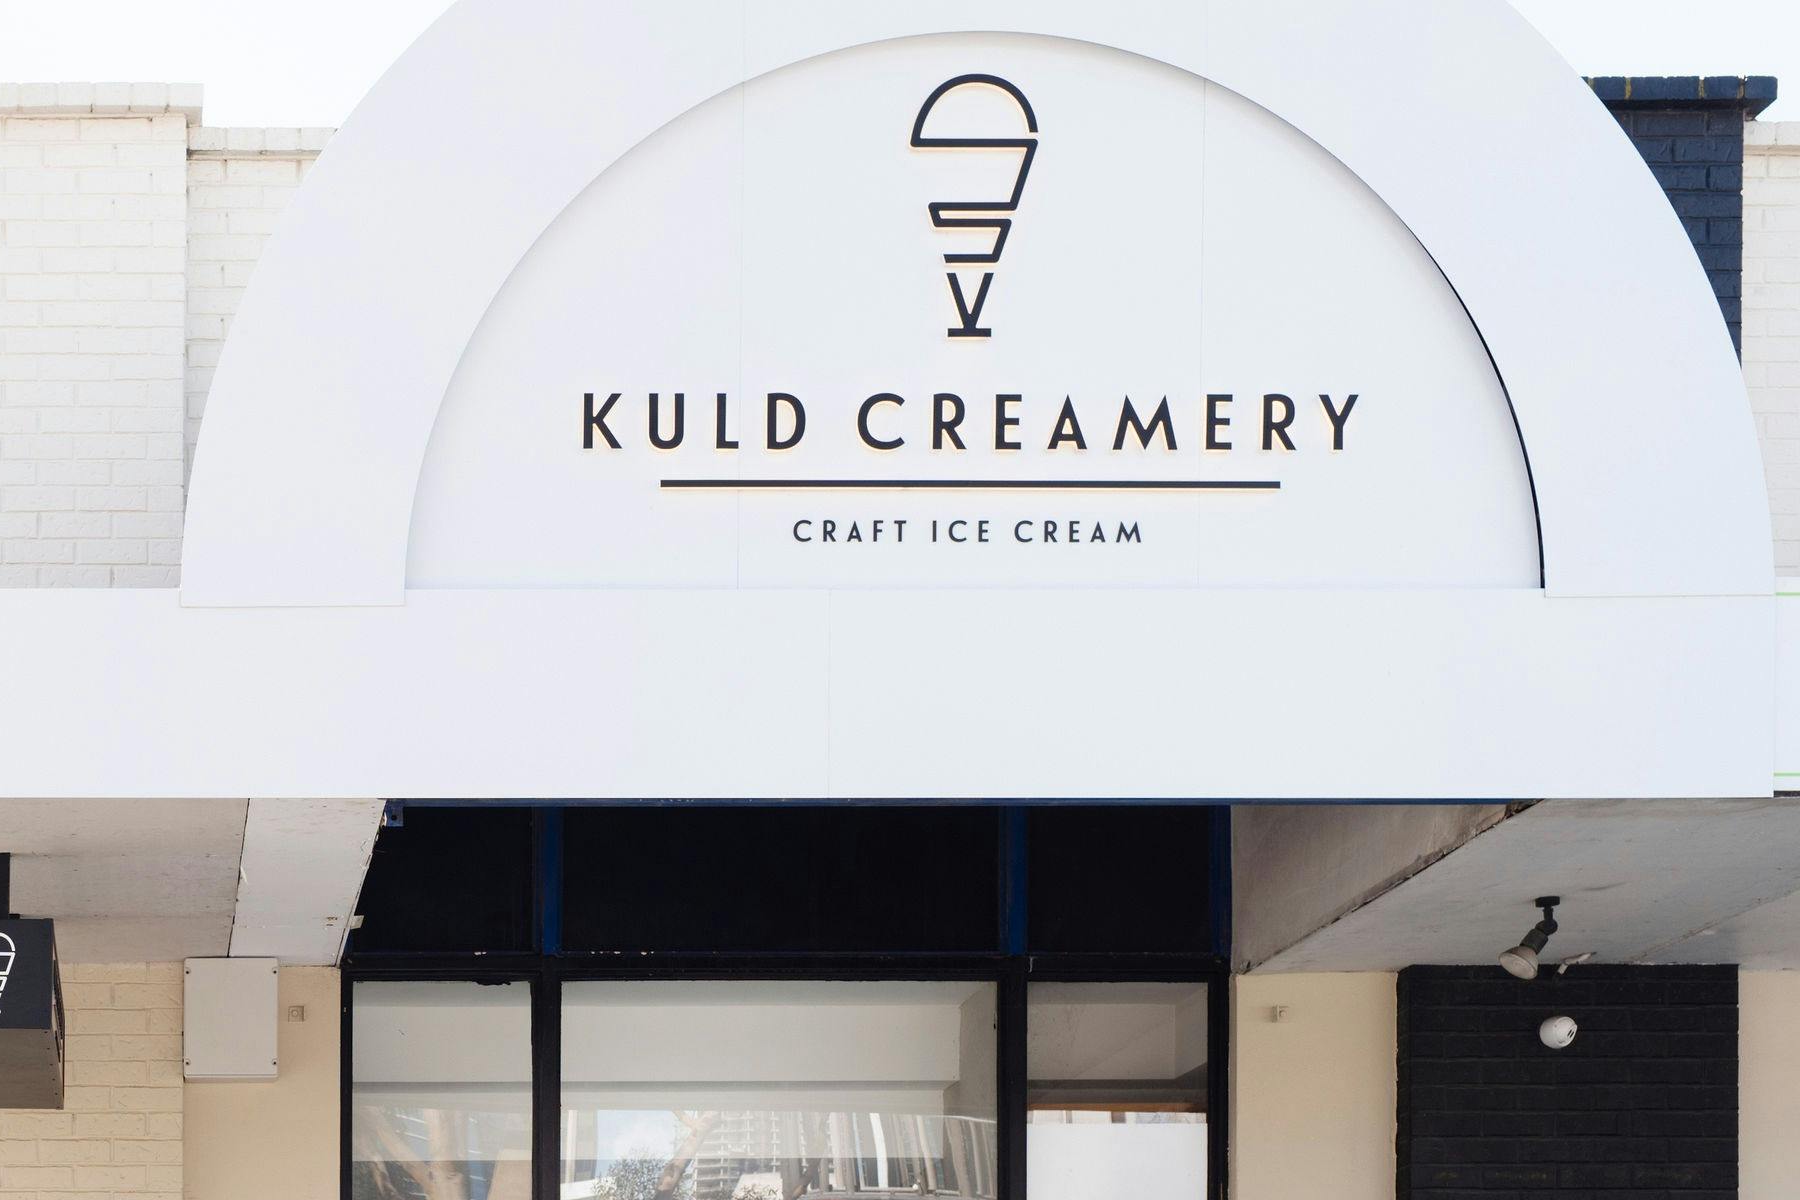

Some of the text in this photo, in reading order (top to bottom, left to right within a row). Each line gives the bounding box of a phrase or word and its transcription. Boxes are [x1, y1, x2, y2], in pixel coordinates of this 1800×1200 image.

[583, 392, 1359, 451] KULD CREAMERY
[793, 519, 1142, 543] CRAFT ICE CREAM
